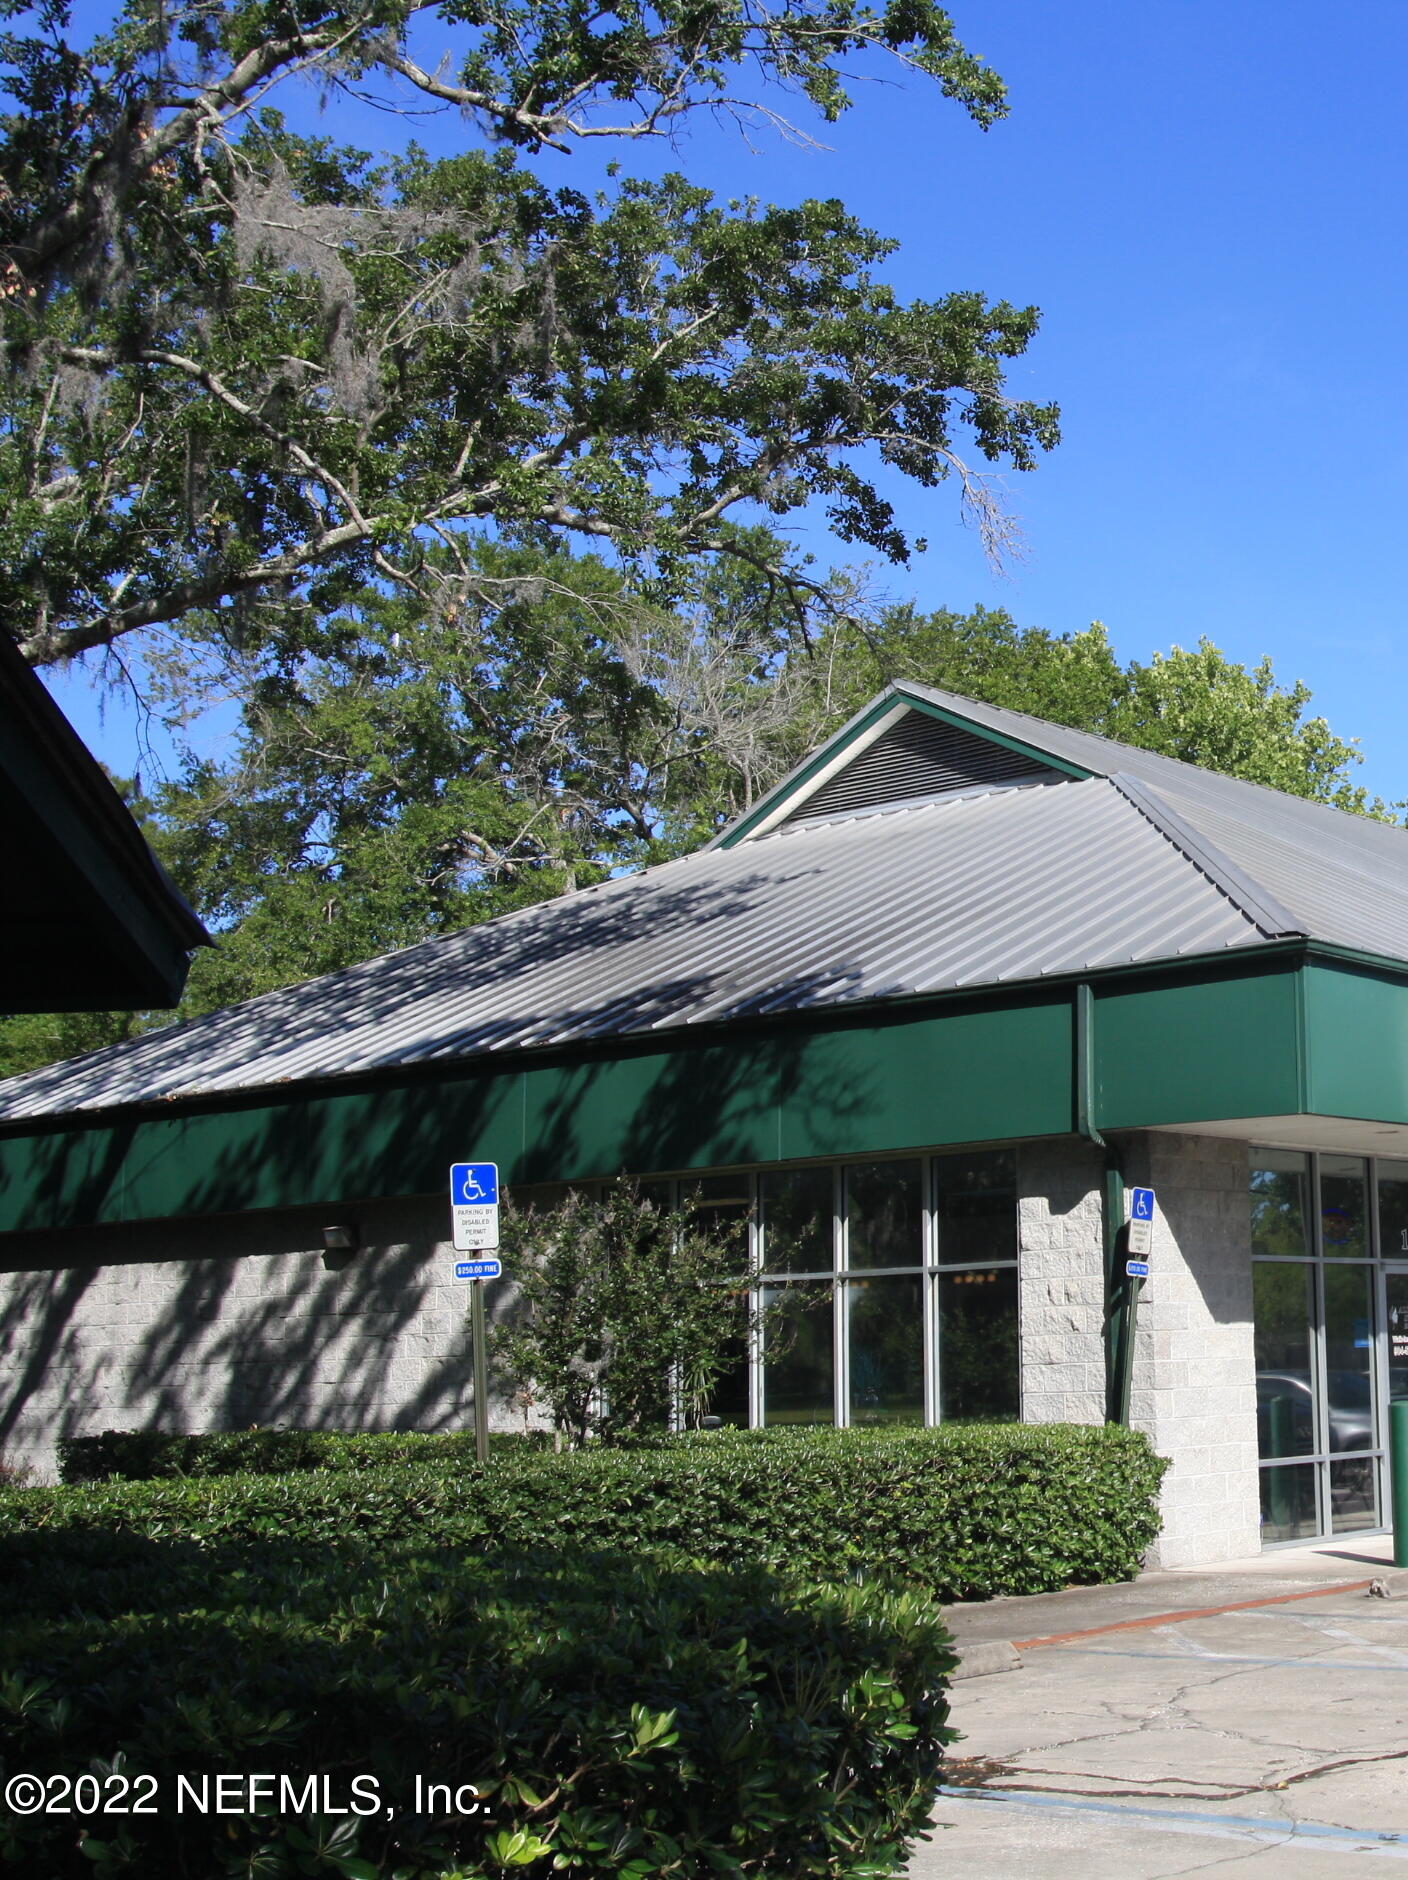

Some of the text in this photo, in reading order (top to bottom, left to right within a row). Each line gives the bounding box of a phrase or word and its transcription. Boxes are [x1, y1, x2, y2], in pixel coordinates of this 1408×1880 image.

[1401, 1228, 1408, 1250] 1
[457, 1264, 498, 1275] $250.00 FINE
